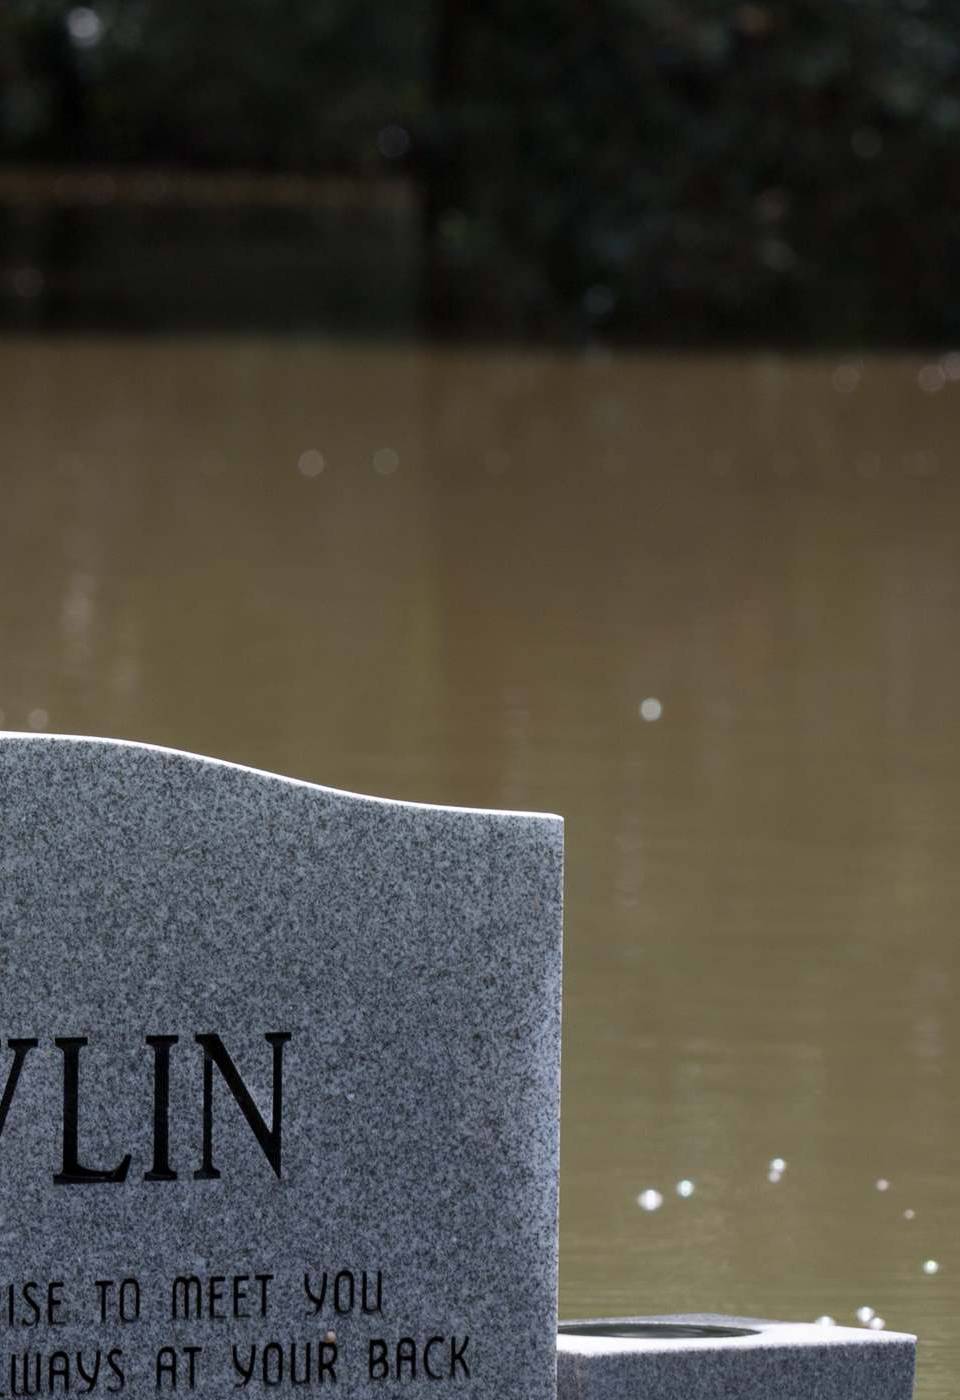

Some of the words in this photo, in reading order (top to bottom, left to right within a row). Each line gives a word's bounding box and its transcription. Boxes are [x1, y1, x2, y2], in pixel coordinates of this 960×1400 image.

[95, 1278, 140, 1323] TO
[172, 1275, 274, 1322] MEET
[304, 1270, 383, 1317] YOU
[0, 1348, 125, 1396] WAYS
[156, 1346, 202, 1391] AT
[232, 1341, 338, 1389] YOUR
[368, 1335, 471, 1381] BACK
